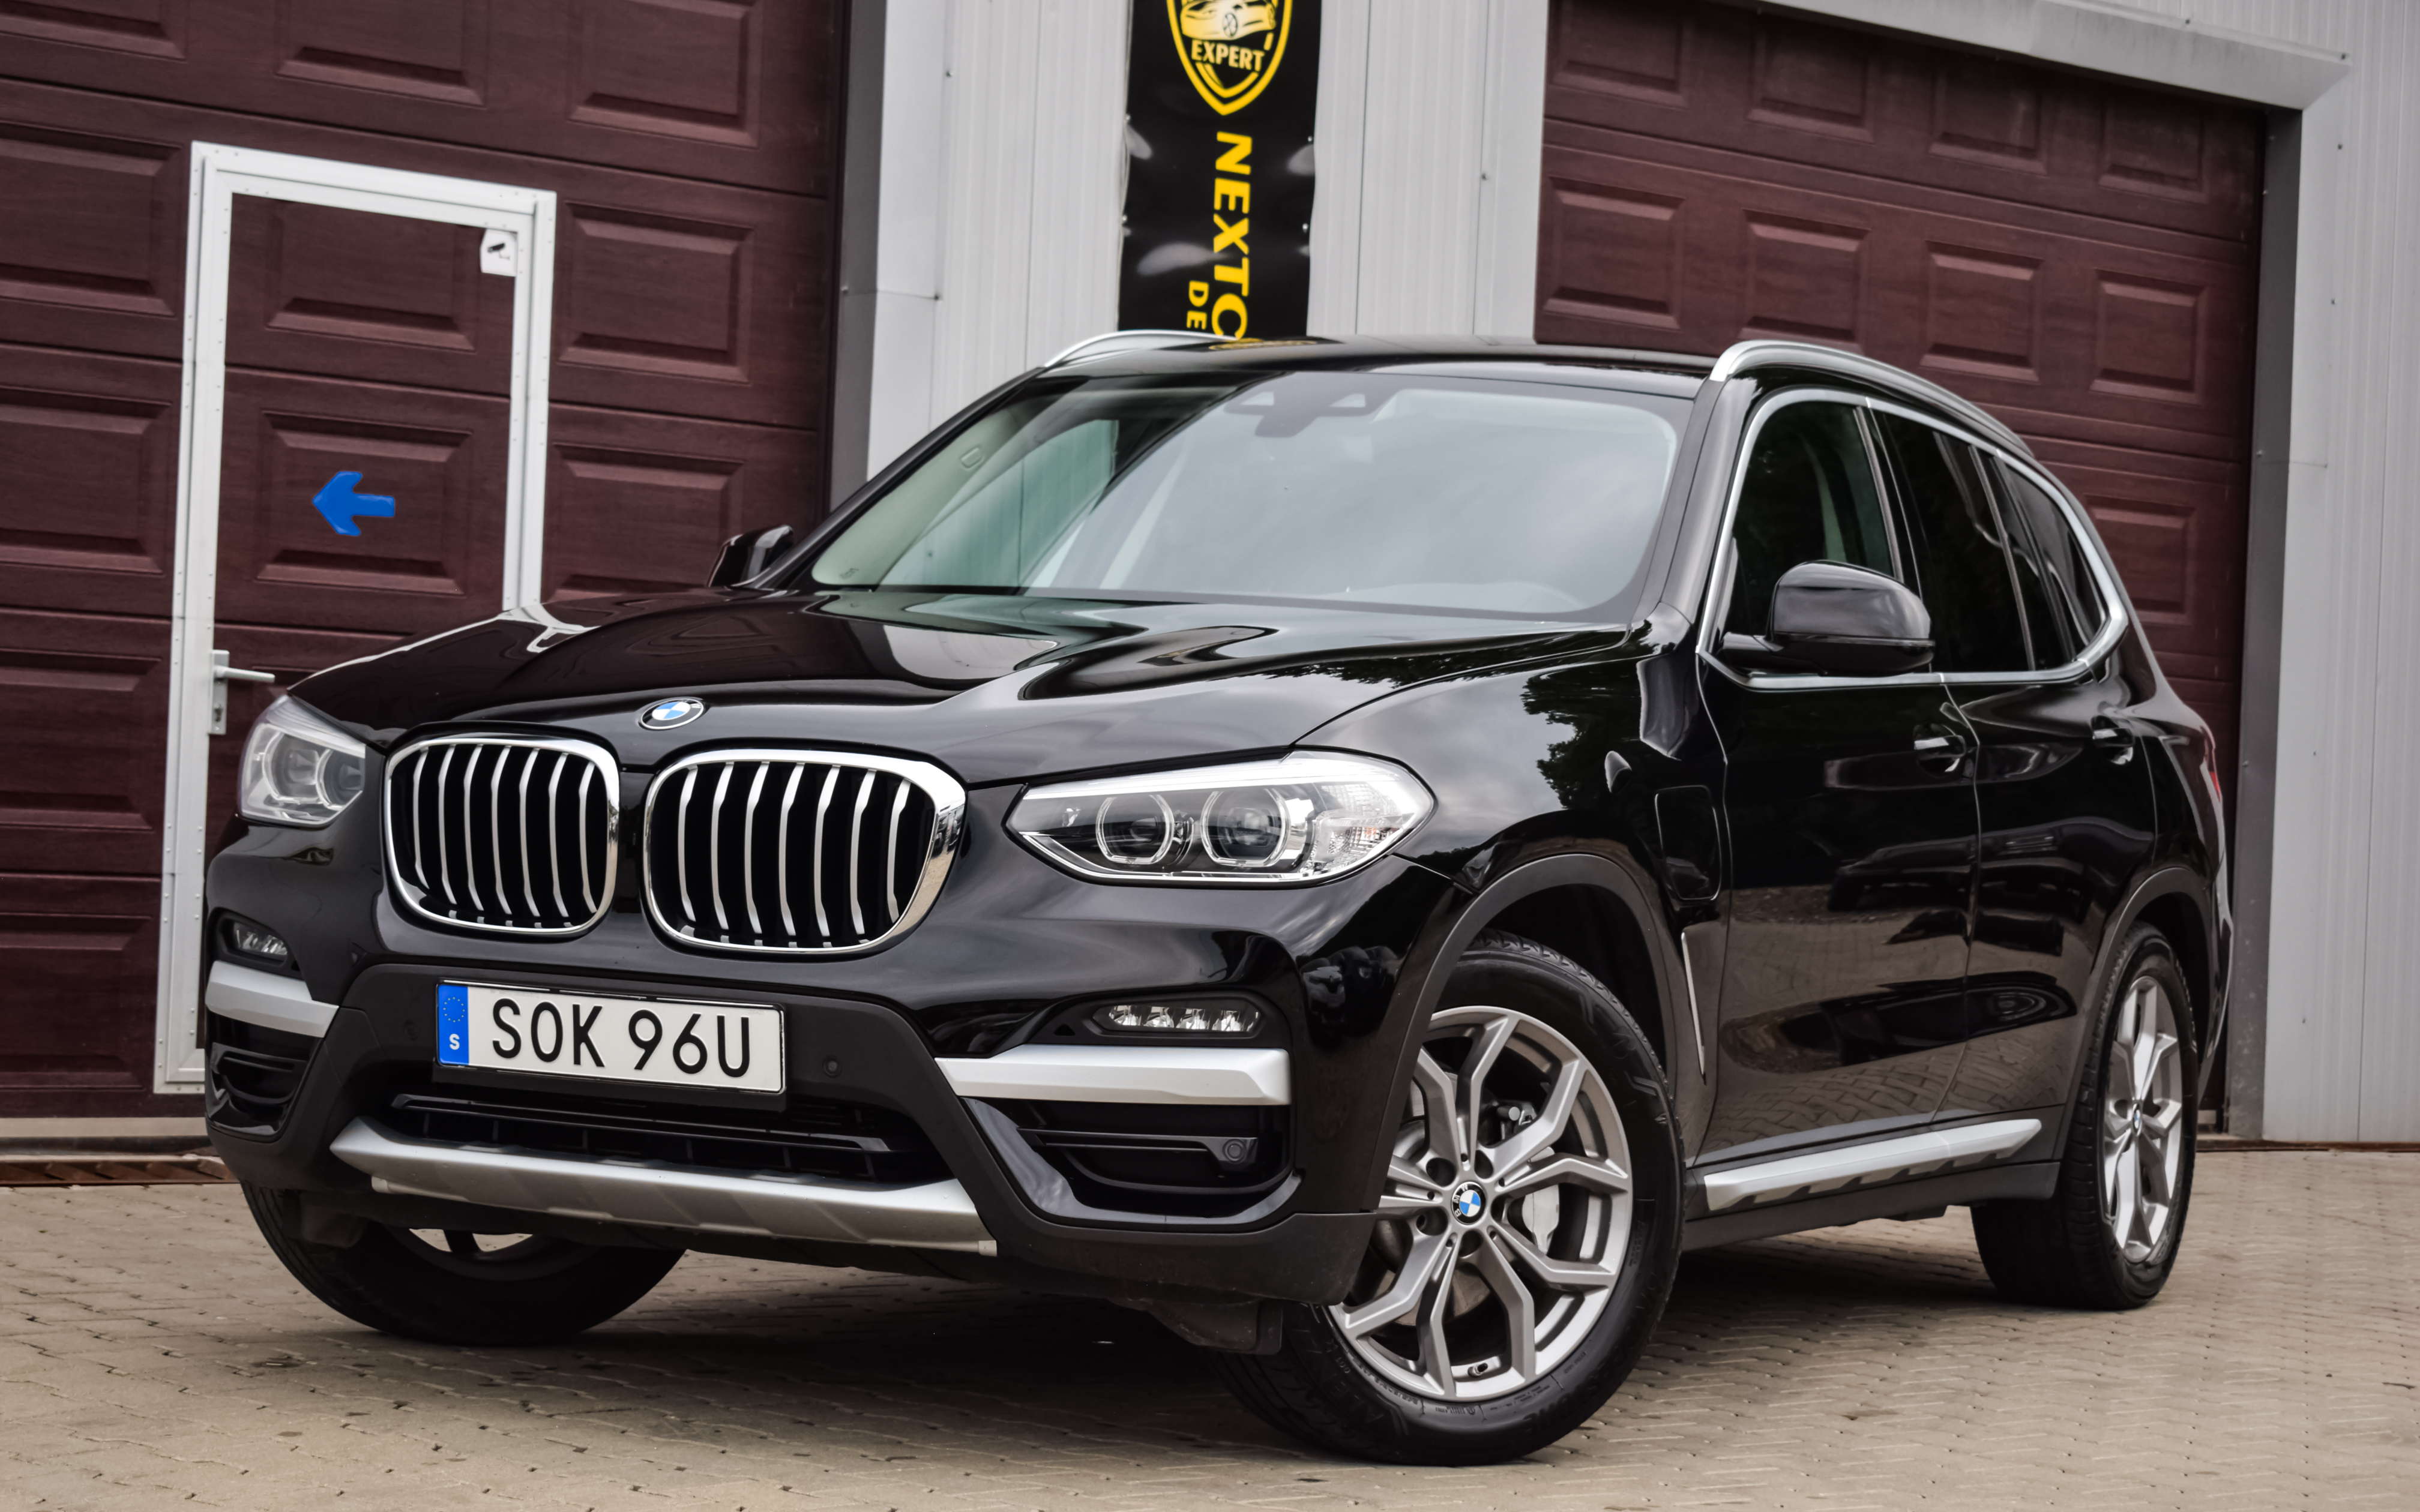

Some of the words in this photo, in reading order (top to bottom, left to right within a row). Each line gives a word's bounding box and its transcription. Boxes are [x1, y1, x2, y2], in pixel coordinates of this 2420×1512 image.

[1191, 38, 1265, 71] EXPERT
[1187, 280, 1209, 330] DE
[449, 1033, 460, 1051] S
[492, 998, 605, 1067] SOK
[628, 1009, 750, 1078] 96U
[1453, 1183, 1468, 1217] BMW
